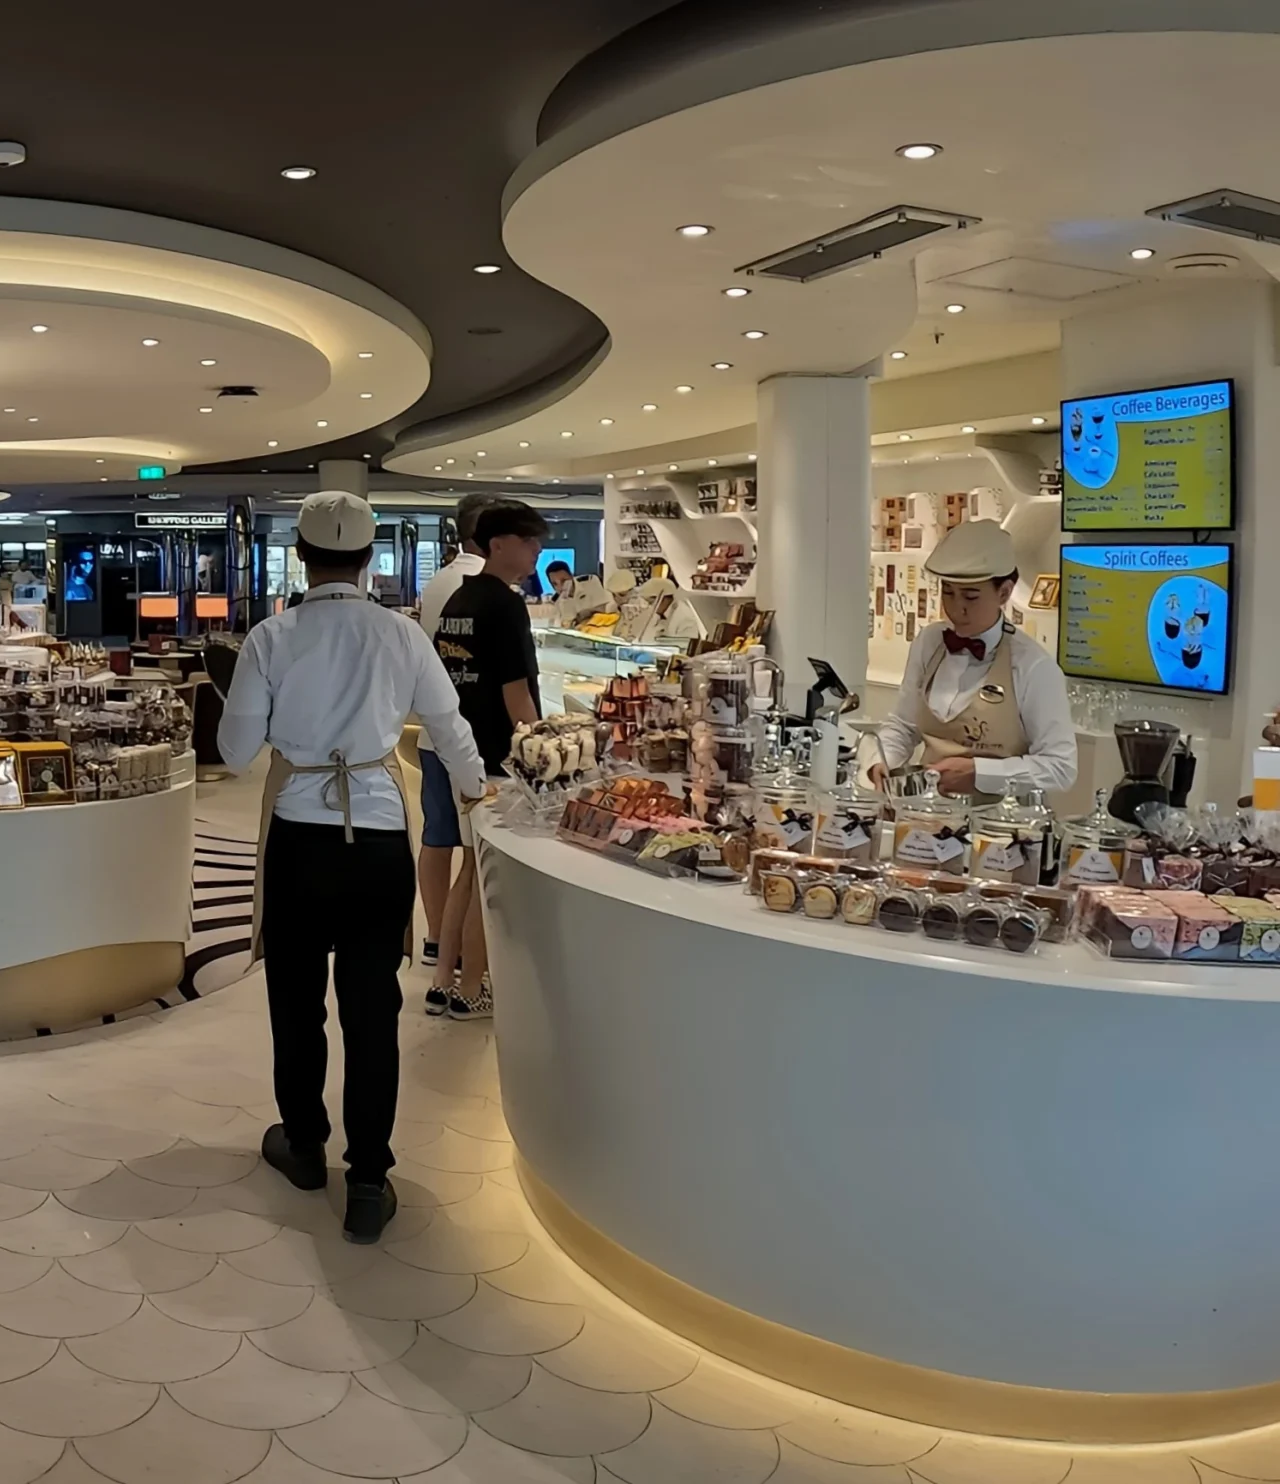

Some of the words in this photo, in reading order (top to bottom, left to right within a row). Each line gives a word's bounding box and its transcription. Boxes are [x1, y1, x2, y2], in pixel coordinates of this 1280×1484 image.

[1112, 398, 1152, 416] Coffee
[1156, 392, 1225, 410] Beverages
[147, 516, 189, 525] SHOPPING
[190, 516, 227, 525] GALLERY
[1104, 550, 1136, 568] Spirit
[1140, 550, 1188, 566] Coffees
